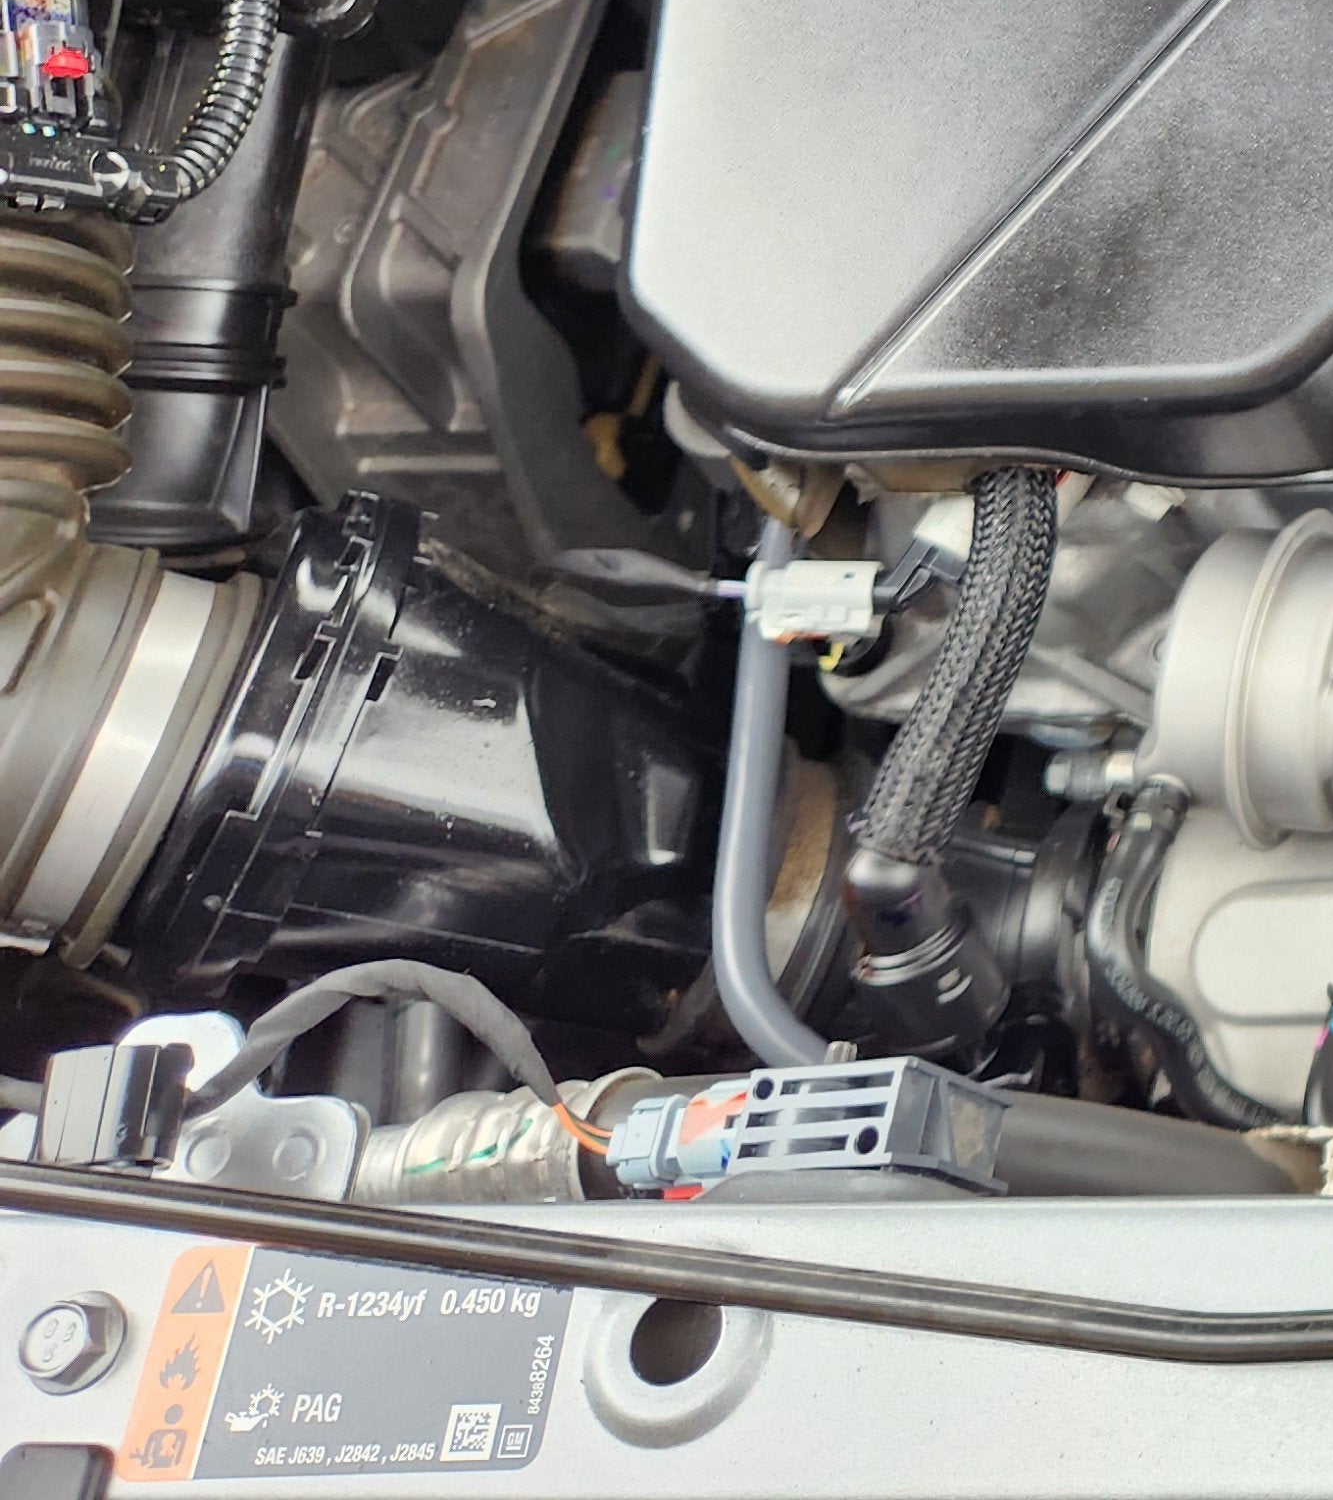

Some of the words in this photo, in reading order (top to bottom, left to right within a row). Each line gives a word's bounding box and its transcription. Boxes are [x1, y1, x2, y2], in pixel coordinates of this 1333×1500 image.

[317, 1289, 428, 1321] R-1234yf
[440, 1288, 505, 1315] 0.450
[510, 1288, 542, 1318] kg
[527, 1334, 555, 1415] 84388264
[291, 1393, 342, 1423] PAG
[254, 1446, 288, 1466] SAE
[389, 1443, 436, 1462] J2845
